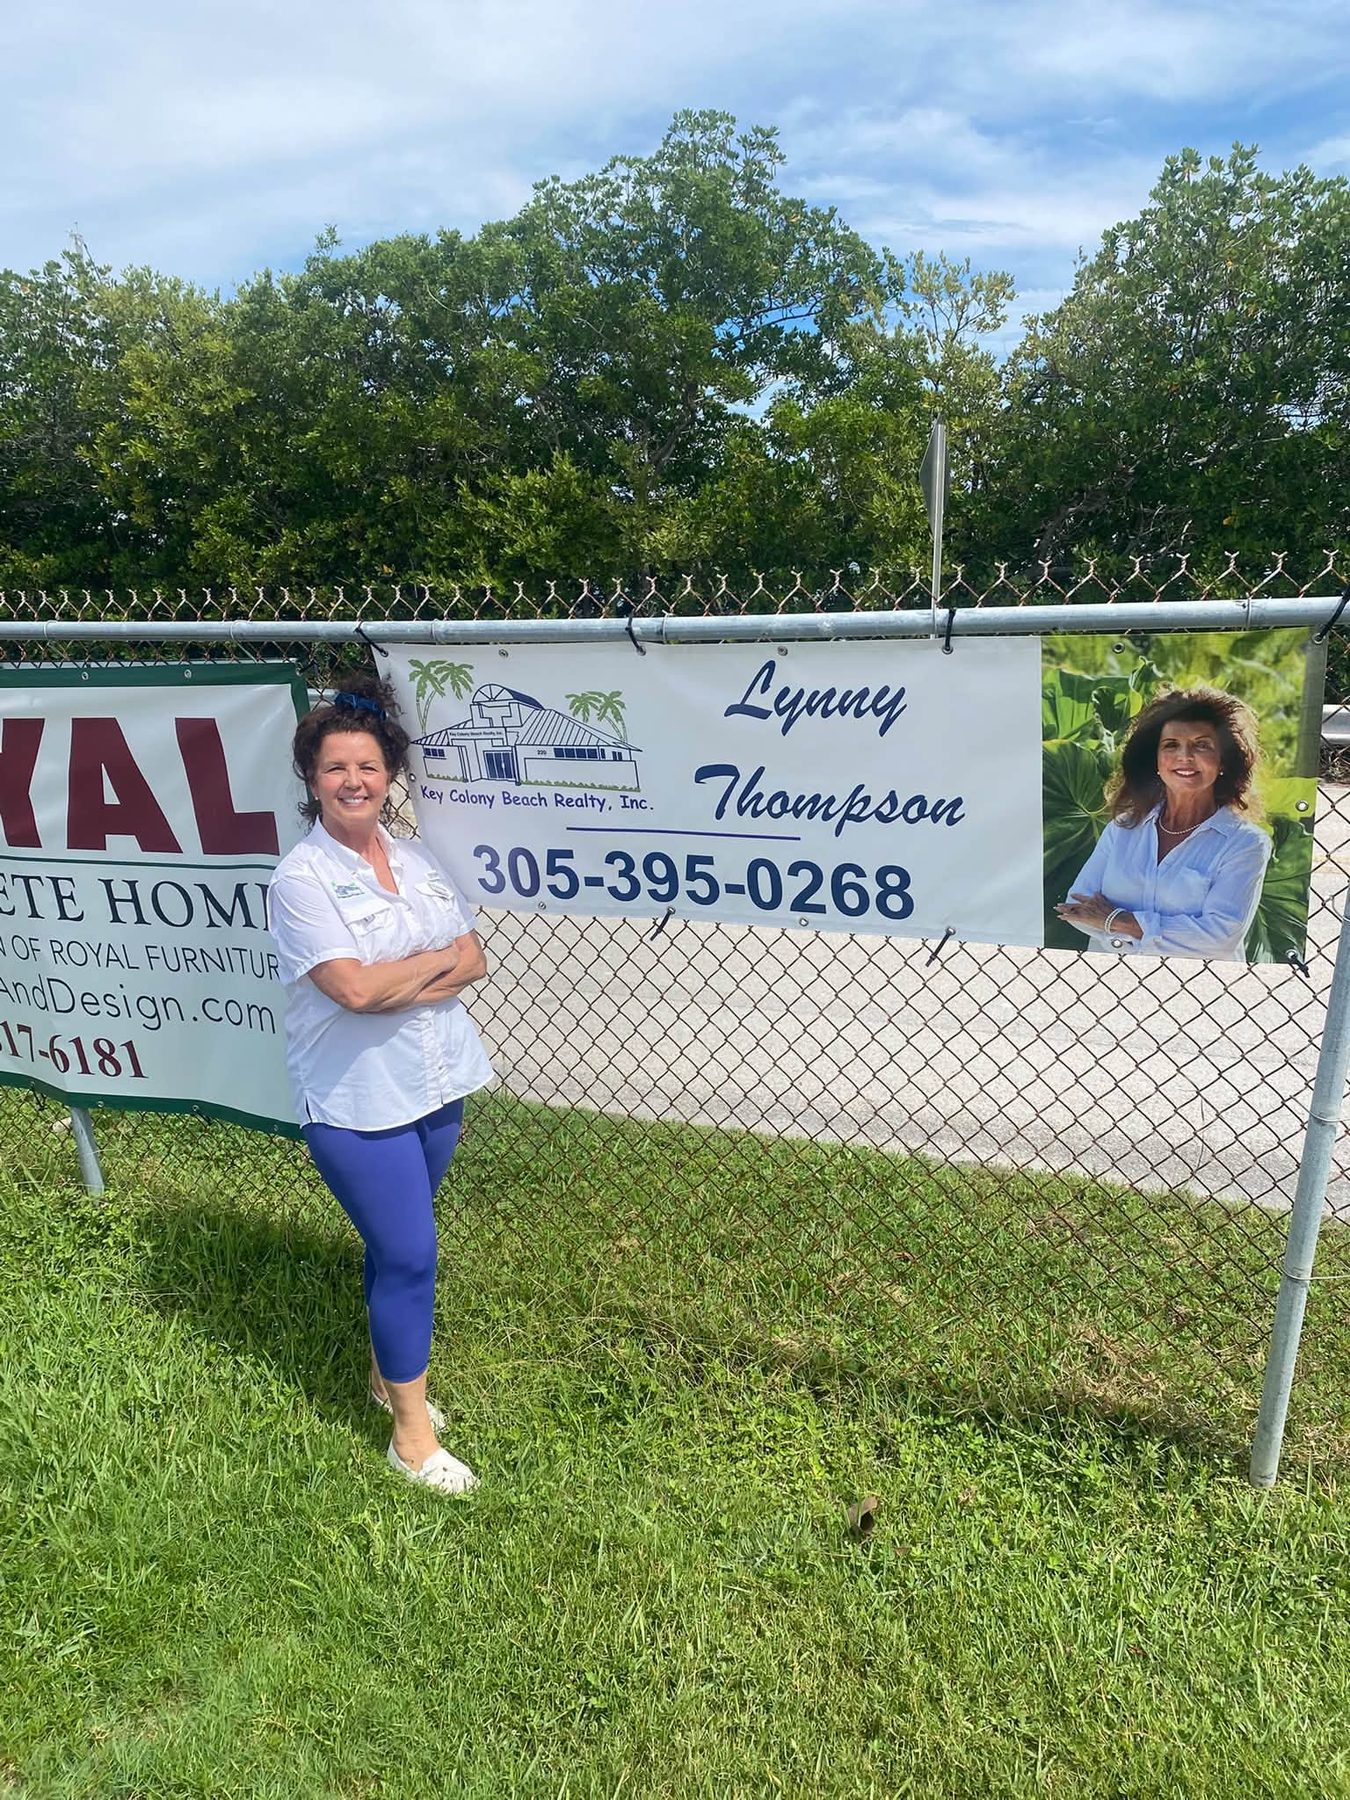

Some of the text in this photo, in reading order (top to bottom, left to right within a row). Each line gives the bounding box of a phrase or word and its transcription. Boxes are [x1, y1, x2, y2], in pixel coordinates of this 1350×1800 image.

[723, 660, 908, 737] Lynny
[420, 784, 654, 813] Key Colony Beach Realty, Inc.
[694, 763, 966, 837] Thompson
[472, 844, 915, 920] 305-395-0268
[11, 934, 41, 962] OF
[49, 939, 139, 970] ROYAL
[0, 1020, 149, 1079] 17-6181
